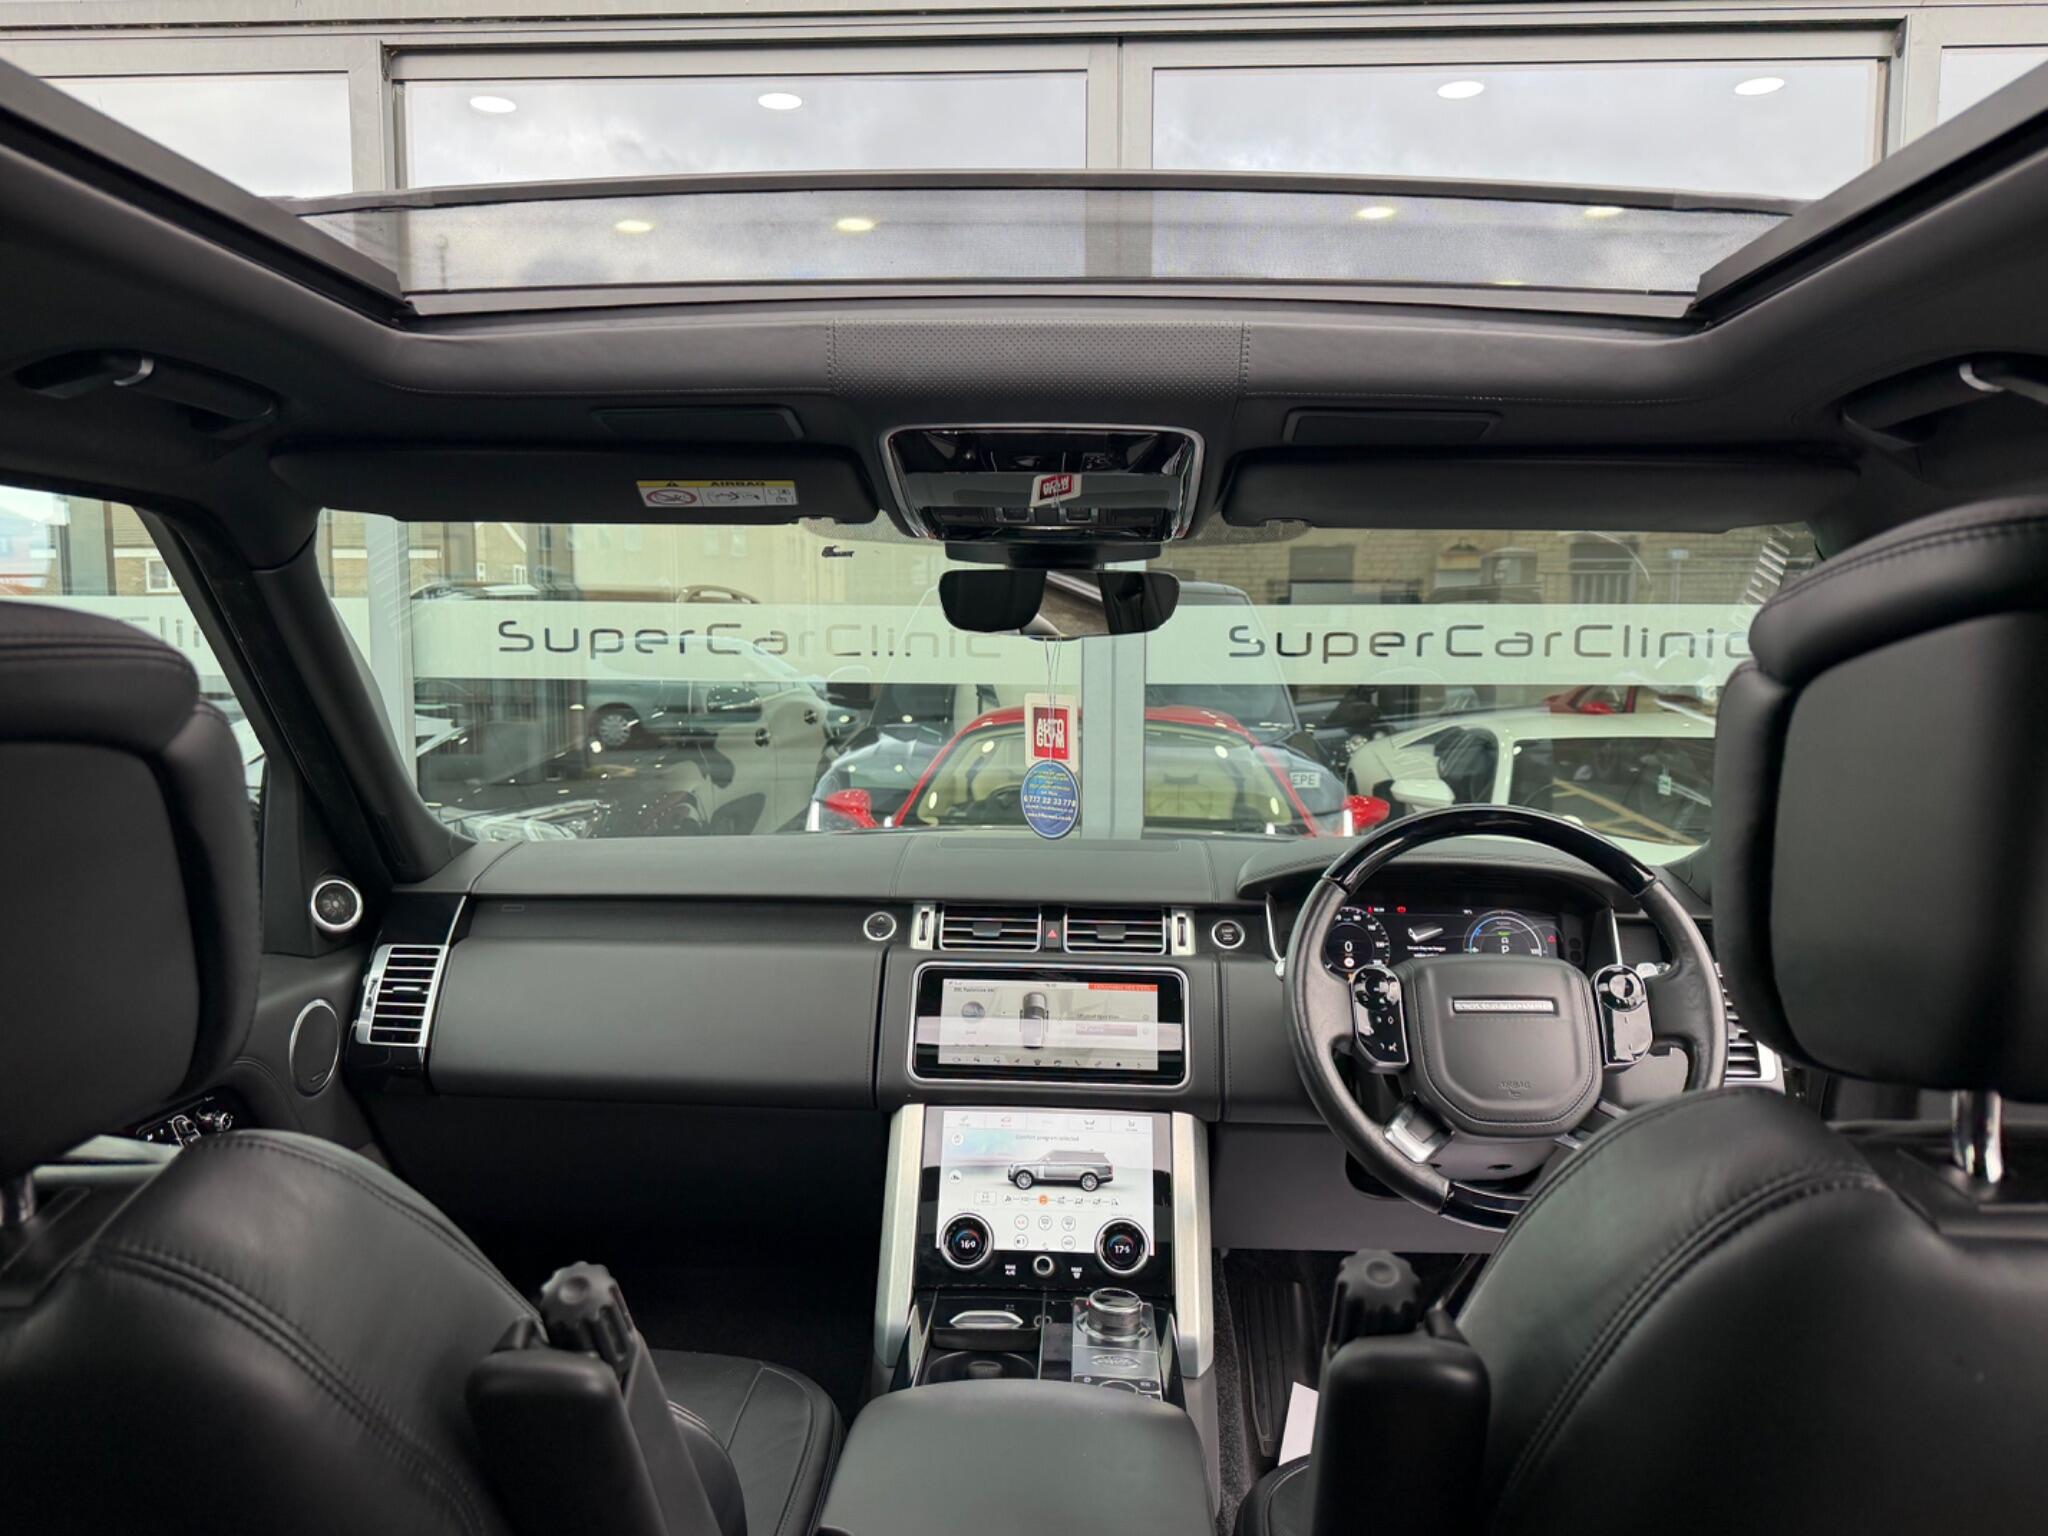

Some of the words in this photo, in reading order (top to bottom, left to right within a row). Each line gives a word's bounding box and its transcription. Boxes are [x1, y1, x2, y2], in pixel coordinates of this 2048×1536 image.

[498, 620, 1003, 660] SuperCarClinic
[1229, 624, 1750, 664] SuperCarClinic
[1036, 719, 1064, 734] AUTO
[1036, 735, 1065, 749] GLYM
[1344, 940, 1353, 952] 0
[1501, 945, 1510, 954] P
